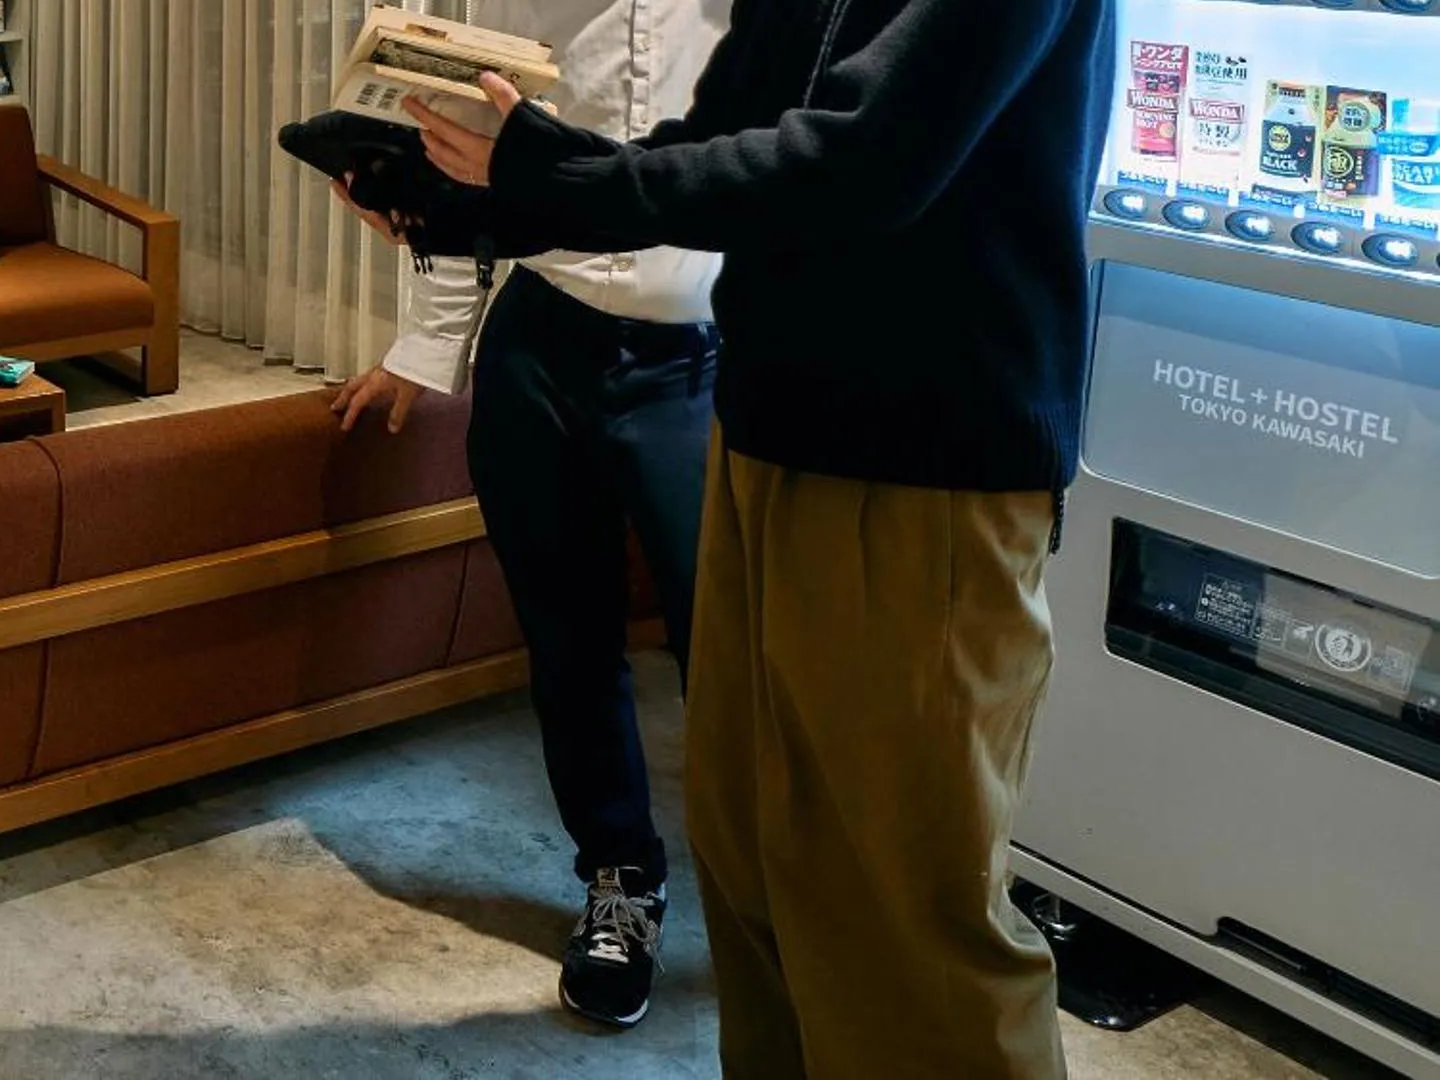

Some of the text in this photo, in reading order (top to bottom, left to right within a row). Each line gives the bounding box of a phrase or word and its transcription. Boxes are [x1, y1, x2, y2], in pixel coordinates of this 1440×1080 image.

[1153, 359, 1399, 444] HOTEL + HOSTEL
[1178, 393, 1365, 459] TOKYO KAWASAKI
